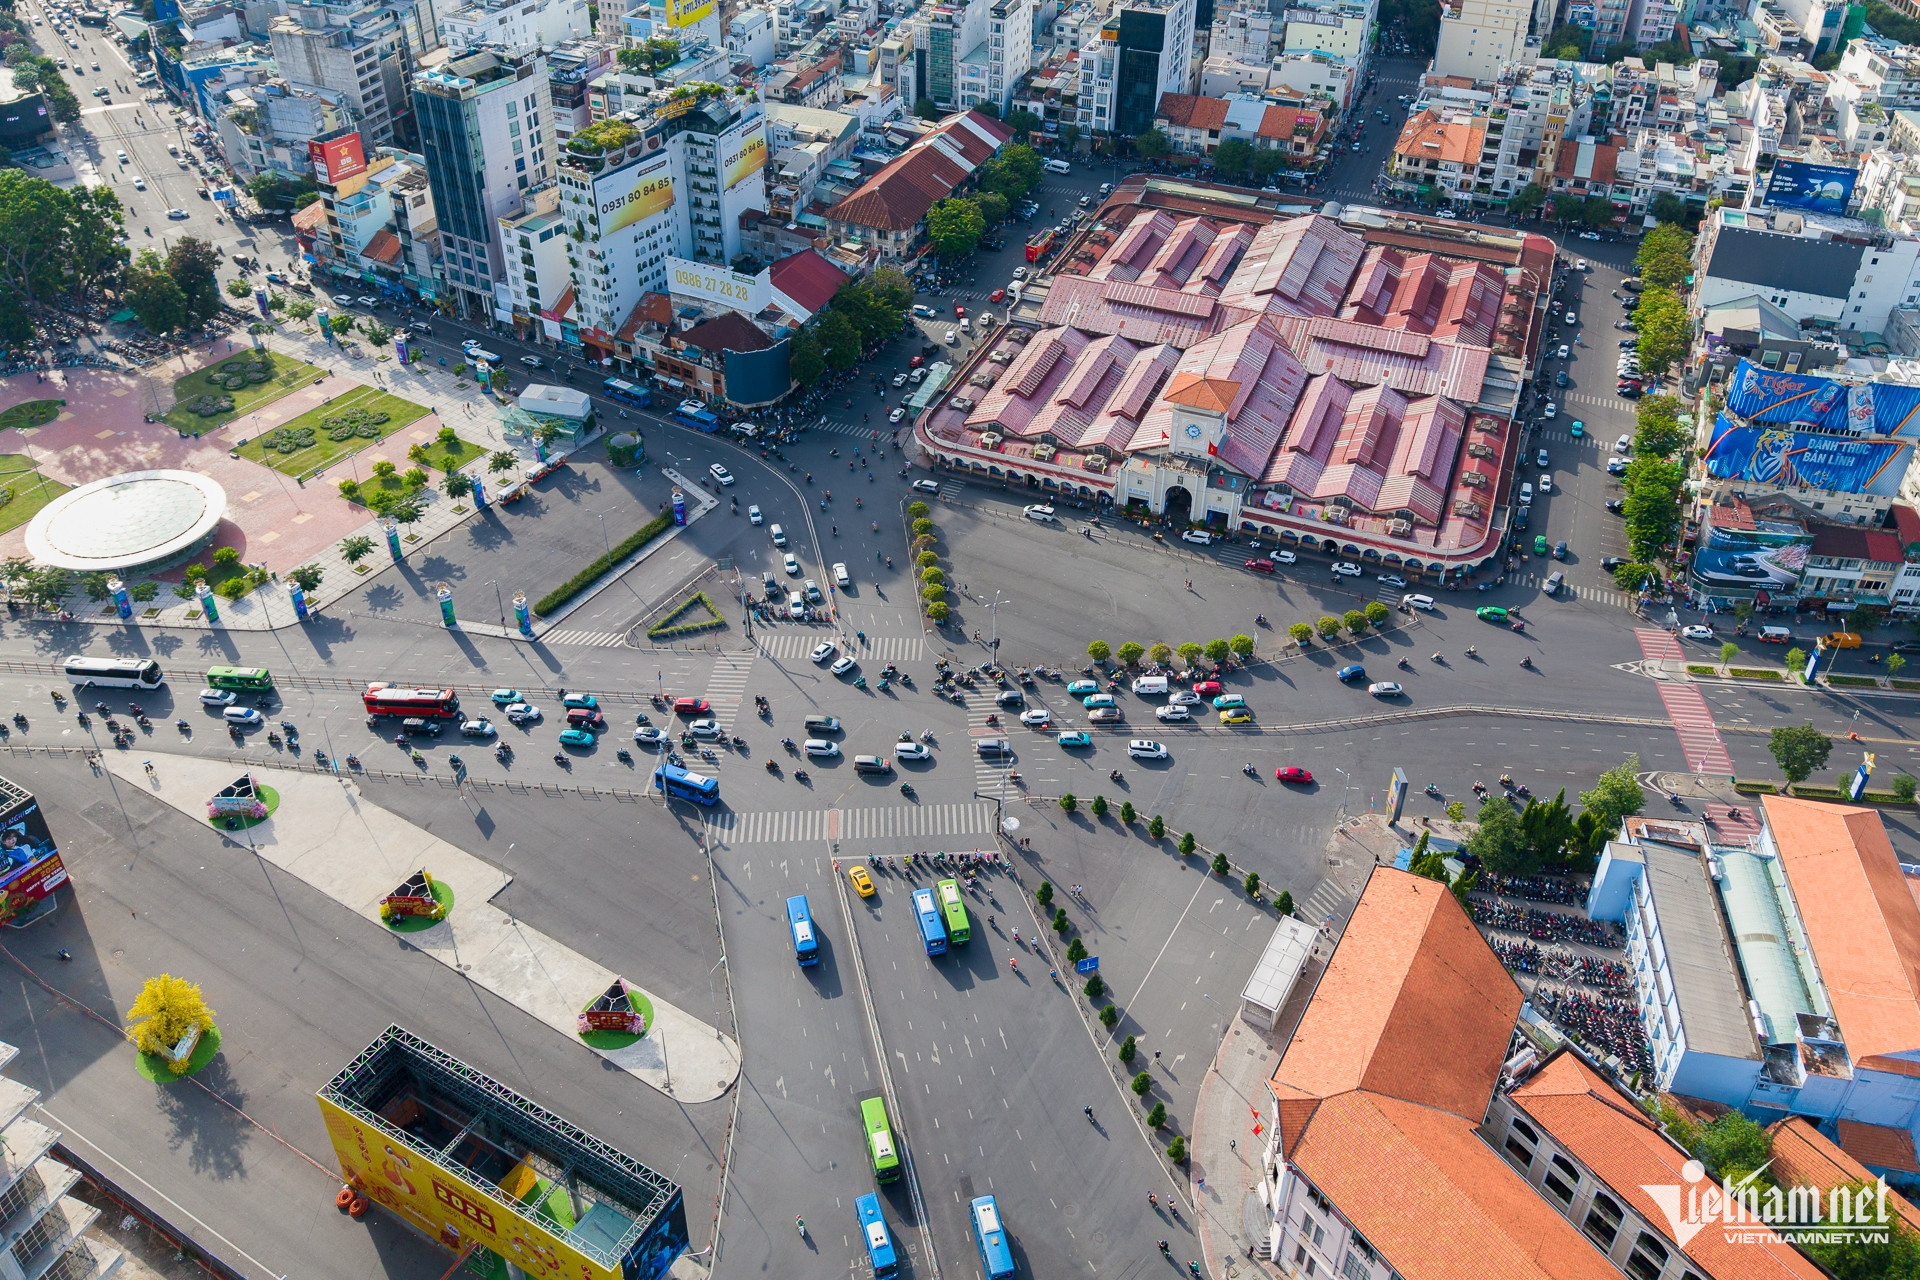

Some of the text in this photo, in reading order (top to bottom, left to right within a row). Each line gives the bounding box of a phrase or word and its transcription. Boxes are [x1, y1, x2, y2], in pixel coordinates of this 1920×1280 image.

[1296, 10, 1335, 25] HALO HOTEL
[522, 51, 537, 65] hotel
[725, 154, 739, 168] 0931
[739, 151, 747, 160] 80
[748, 144, 757, 154] 84
[558, 167, 589, 180] SILVERLAND
[602, 176, 670, 214] 0931 80 84 85
[675, 269, 702, 289] 0986
[705, 276, 717, 292] 27
[720, 280, 733, 297] 28
[735, 285, 749, 301] 28
[1762, 375, 1806, 395] Tiger
[1808, 437, 1839, 452] ĐÁNH
[1802, 449, 1855, 467] BẢN LĨNH
[1712, 528, 1731, 540] Hybrid
[40, 861, 61, 877] 2025
[26, 881, 40, 893] HAPPY
[40, 875, 50, 883] NEW
[437, 1186, 492, 1228] 2025
[849, 1254, 872, 1271] UÝT
